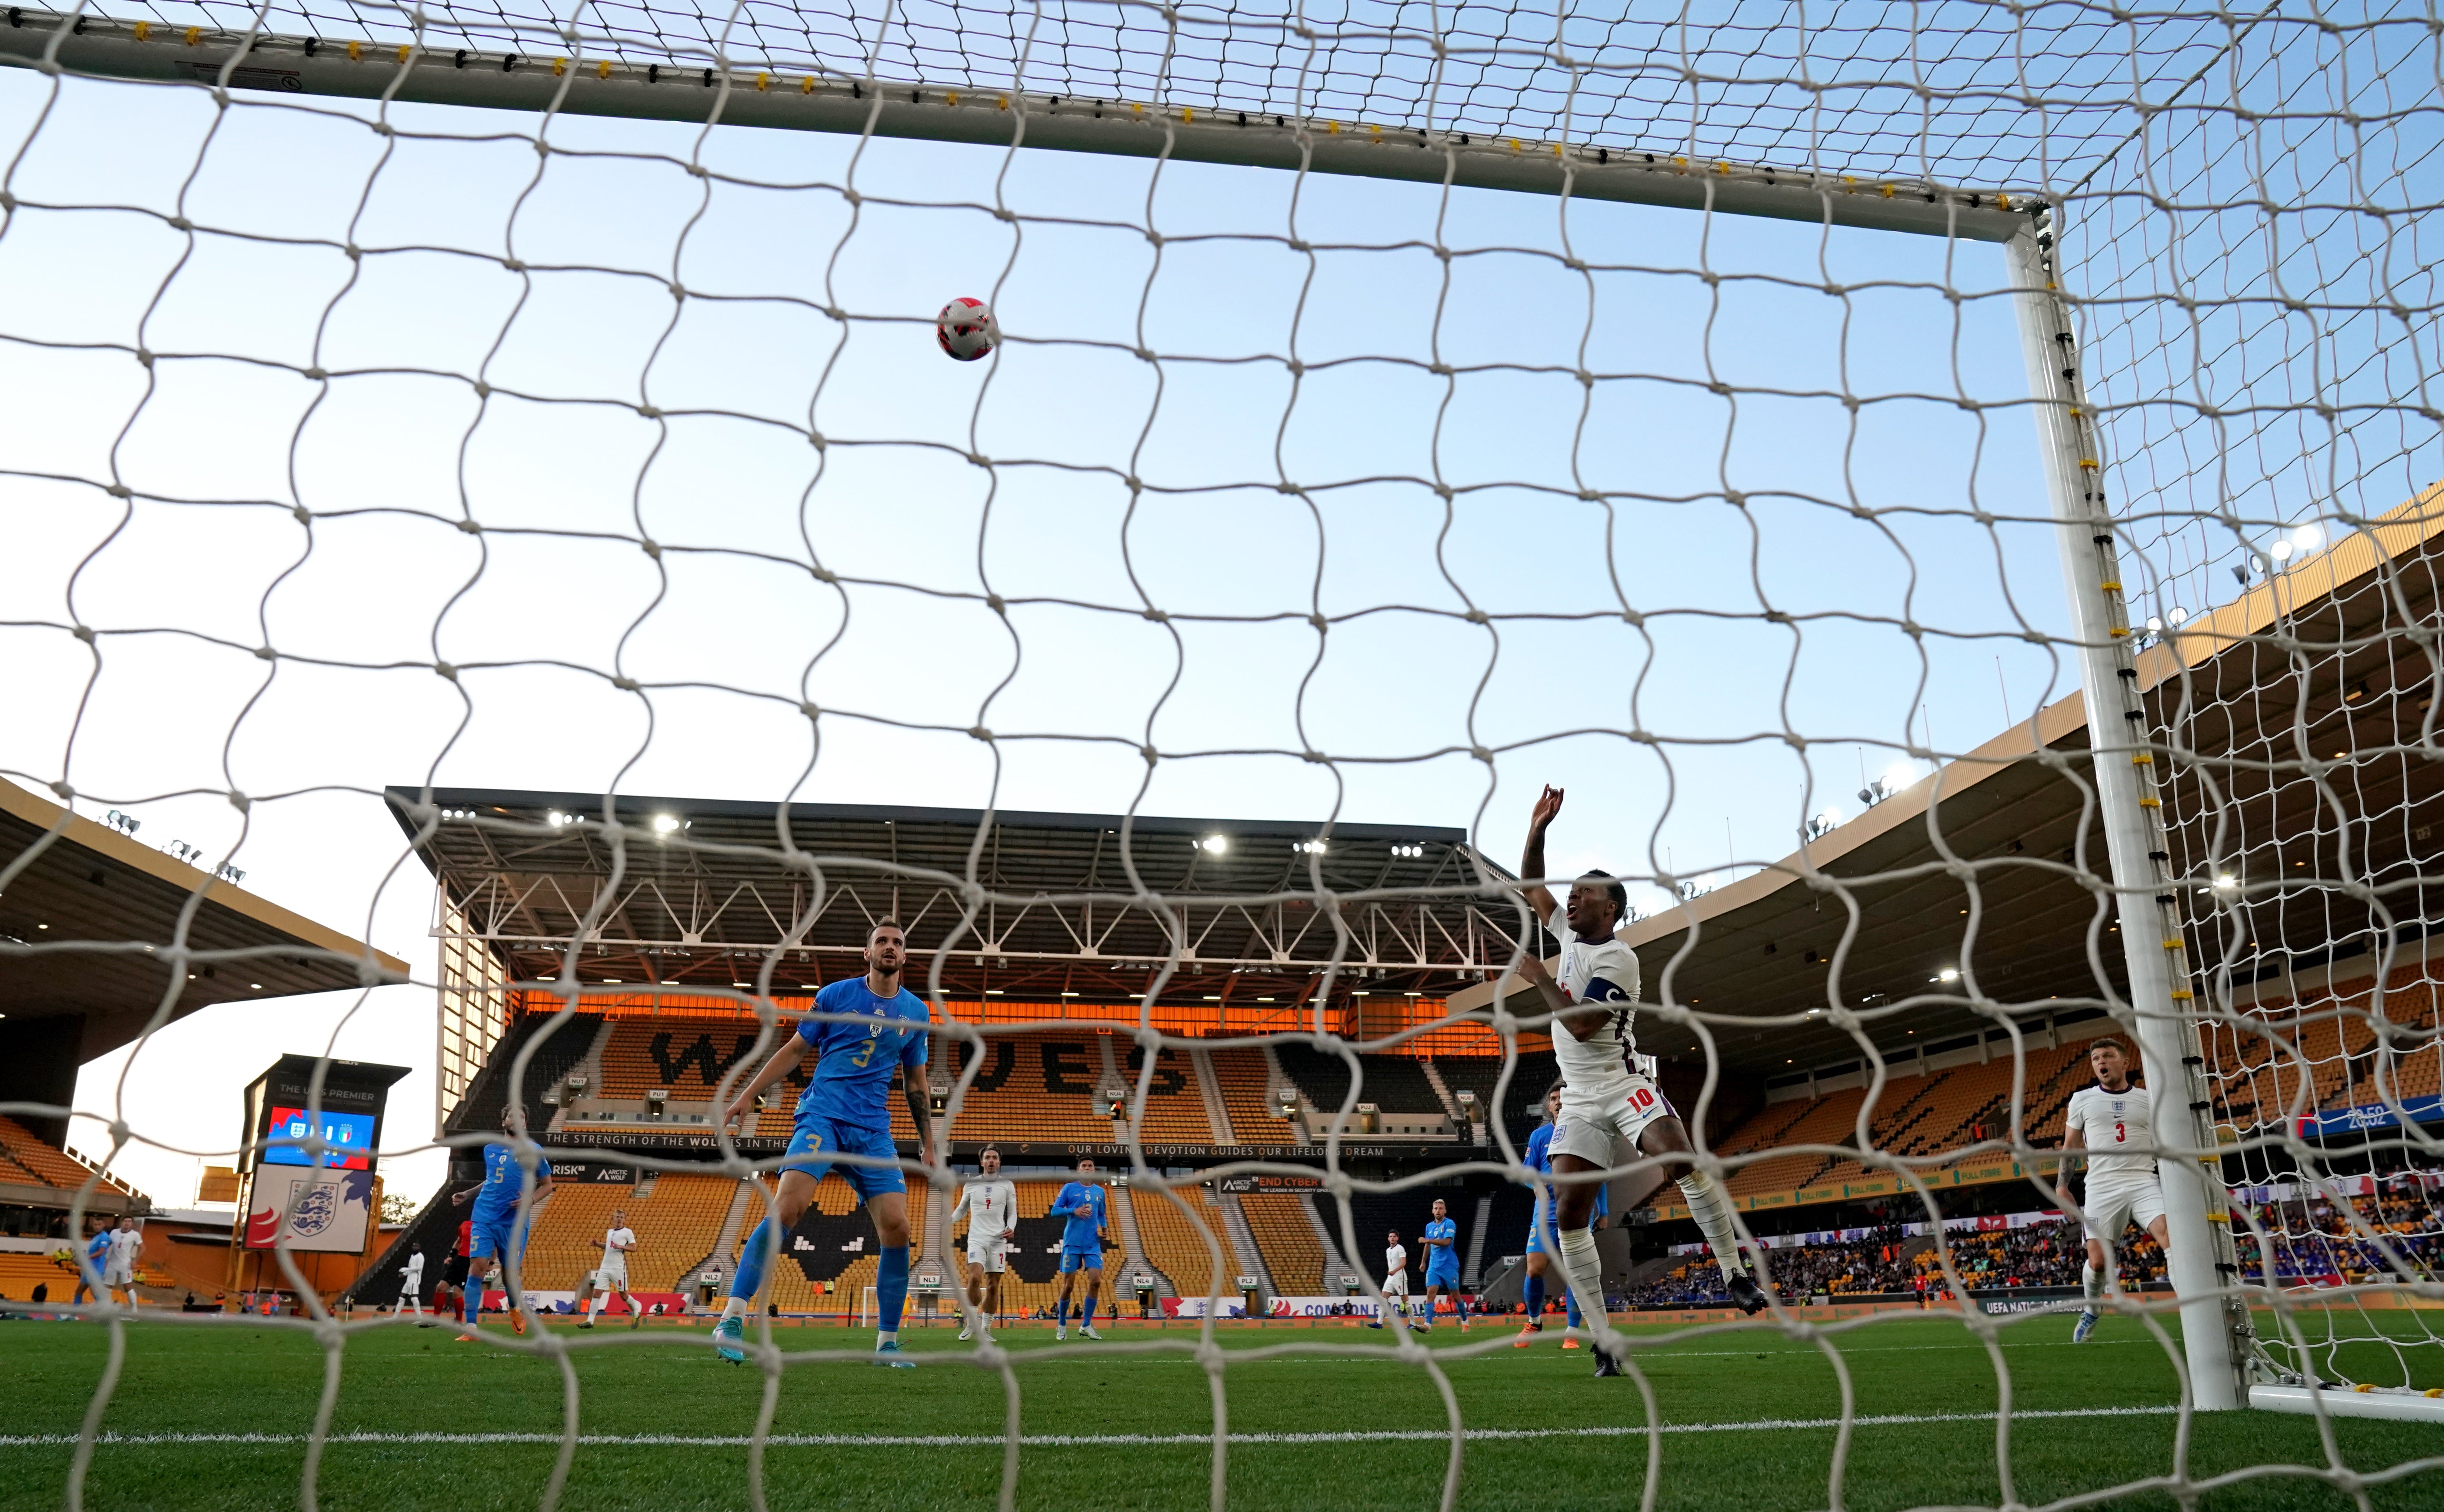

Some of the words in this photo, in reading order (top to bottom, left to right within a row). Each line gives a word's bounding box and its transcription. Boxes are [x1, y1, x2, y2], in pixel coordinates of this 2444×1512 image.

[1606, 988, 1620, 1003] C
[853, 1039, 876, 1067] 3
[280, 1083, 300, 1093] THE
[329, 1089, 375, 1100] PREMIER
[1627, 1088, 1654, 1113] 10
[2116, 1124, 2125, 1142] 3
[547, 1134, 568, 1143] THE
[574, 1135, 635, 1145] STRENGTH
[642, 1136, 657, 1145] OF
[662, 1137, 684, 1146] THE
[747, 1139, 760, 1148] IN
[766, 1139, 788, 1148] THE
[1068, 1145, 1091, 1154] OUR
[1146, 1146, 1205, 1155] DEVOTION
[1211, 1147, 1253, 1156] GUIDES
[1258, 1147, 1281, 1156] OUR
[1346, 1148, 1383, 1156] DREAM
[495, 1167, 505, 1183] 5
[553, 1165, 578, 1175] RISK
[1259, 1177, 1282, 1186] END
[1284, 1177, 1318, 1186] CYBER
[986, 1199, 991, 1209] 7
[1528, 1228, 1536, 1246] 2
[1000, 1253, 1003, 1264] 7
[1351, 1304, 1368, 1315] ON
[1987, 1302, 2009, 1314] UEFA
